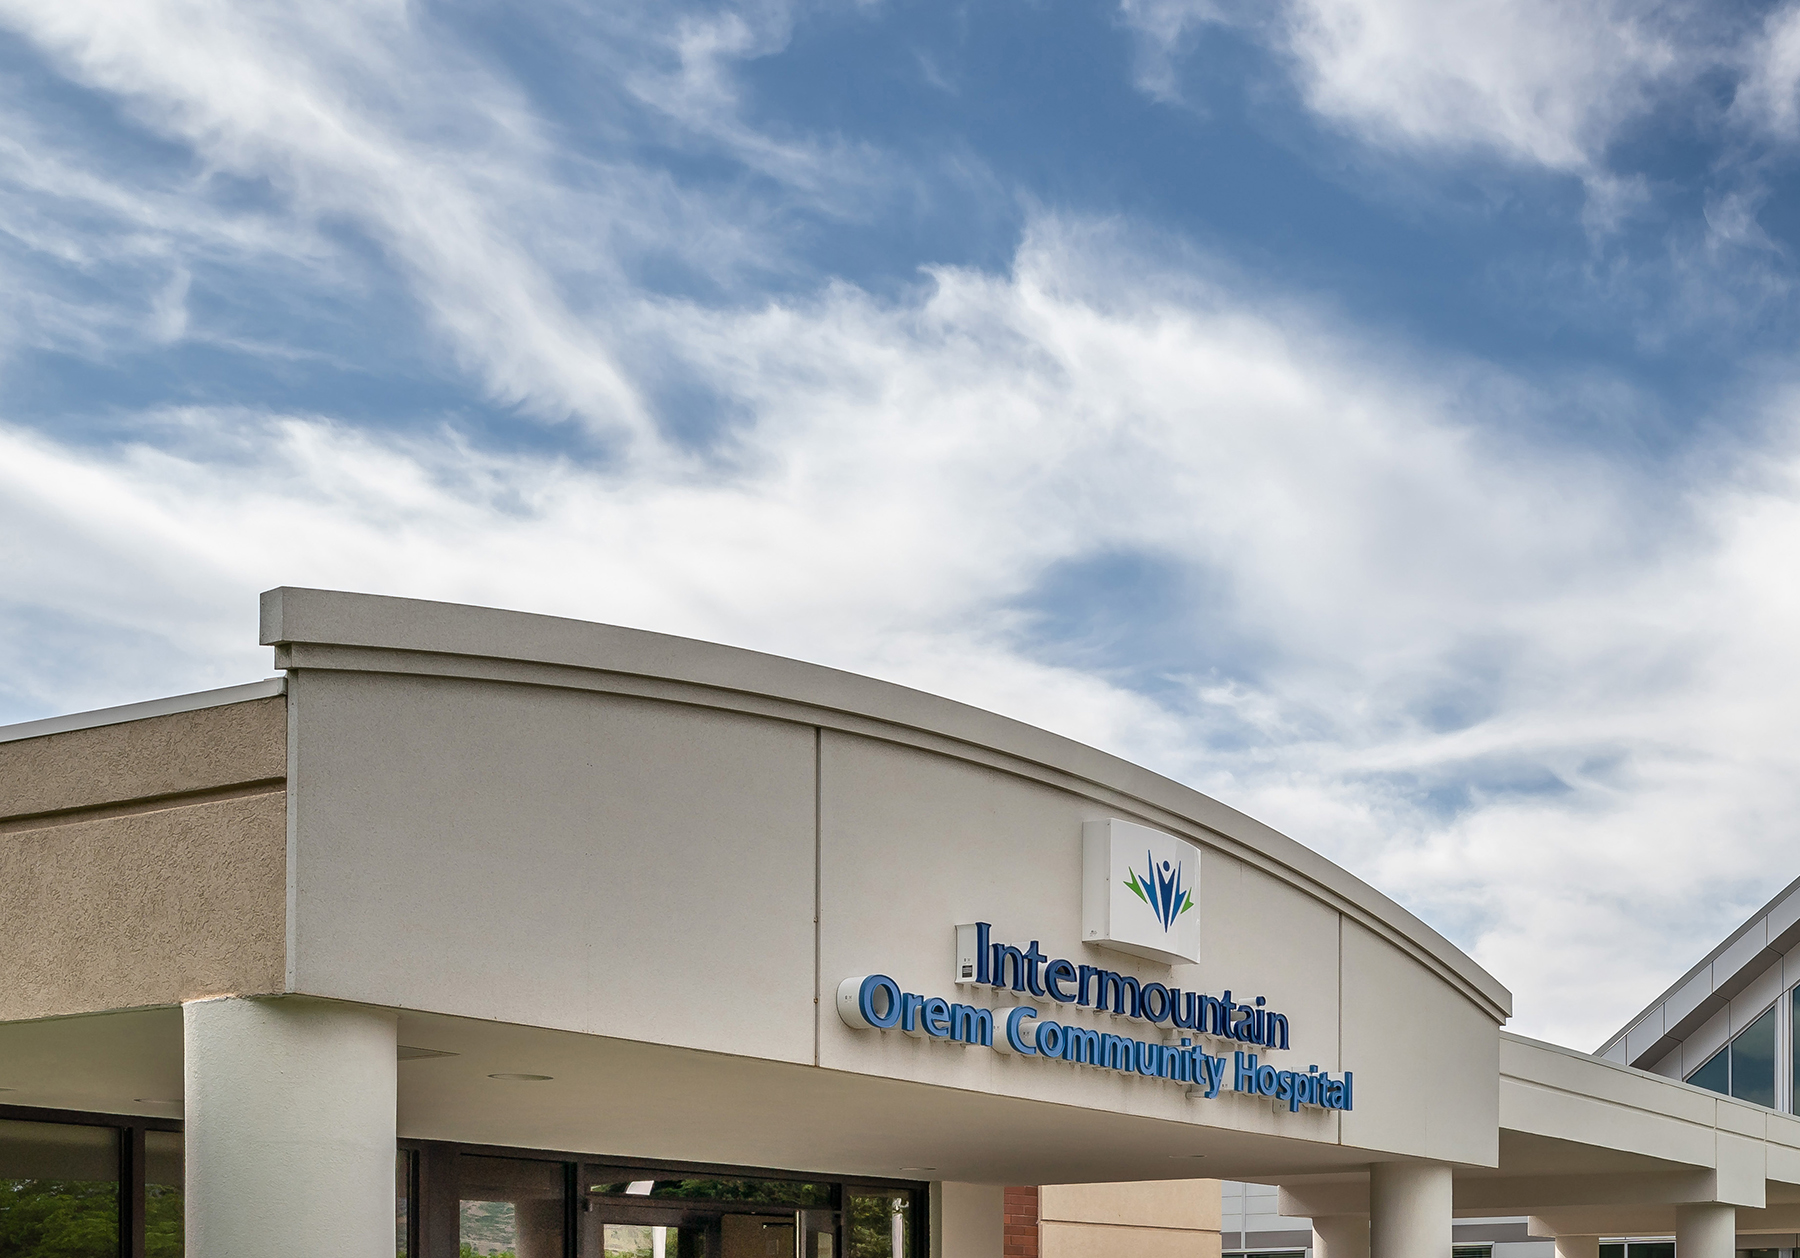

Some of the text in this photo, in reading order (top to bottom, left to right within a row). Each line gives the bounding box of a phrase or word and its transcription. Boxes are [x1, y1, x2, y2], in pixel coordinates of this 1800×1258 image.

[859, 973, 1354, 1113] Orem Community Hospital
[975, 921, 1290, 1051] Intermountain
